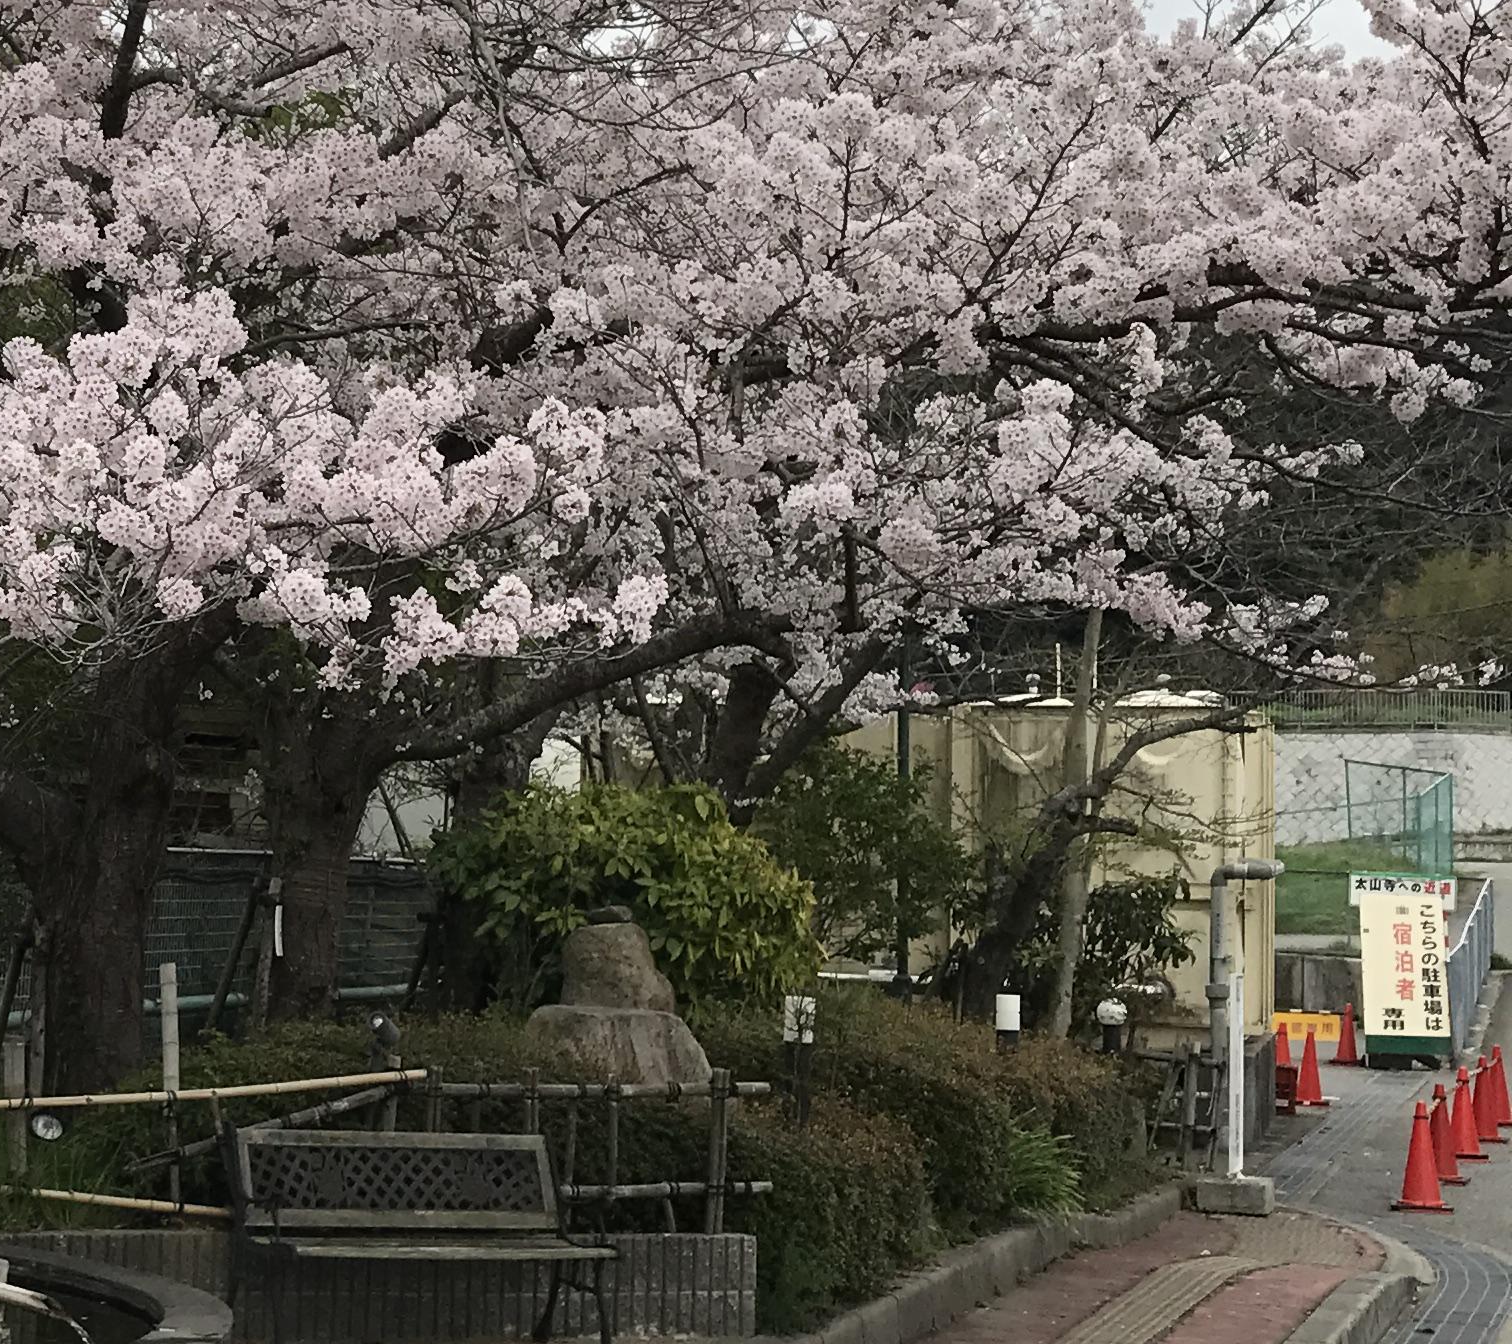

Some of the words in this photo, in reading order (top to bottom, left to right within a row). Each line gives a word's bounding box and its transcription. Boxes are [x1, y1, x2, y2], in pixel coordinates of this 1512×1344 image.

[1393, 922, 1416, 1001] 宿泊者
[1420, 904, 1444, 1031] こちらの駐車場は
[1382, 1008, 1406, 1031] 専用
